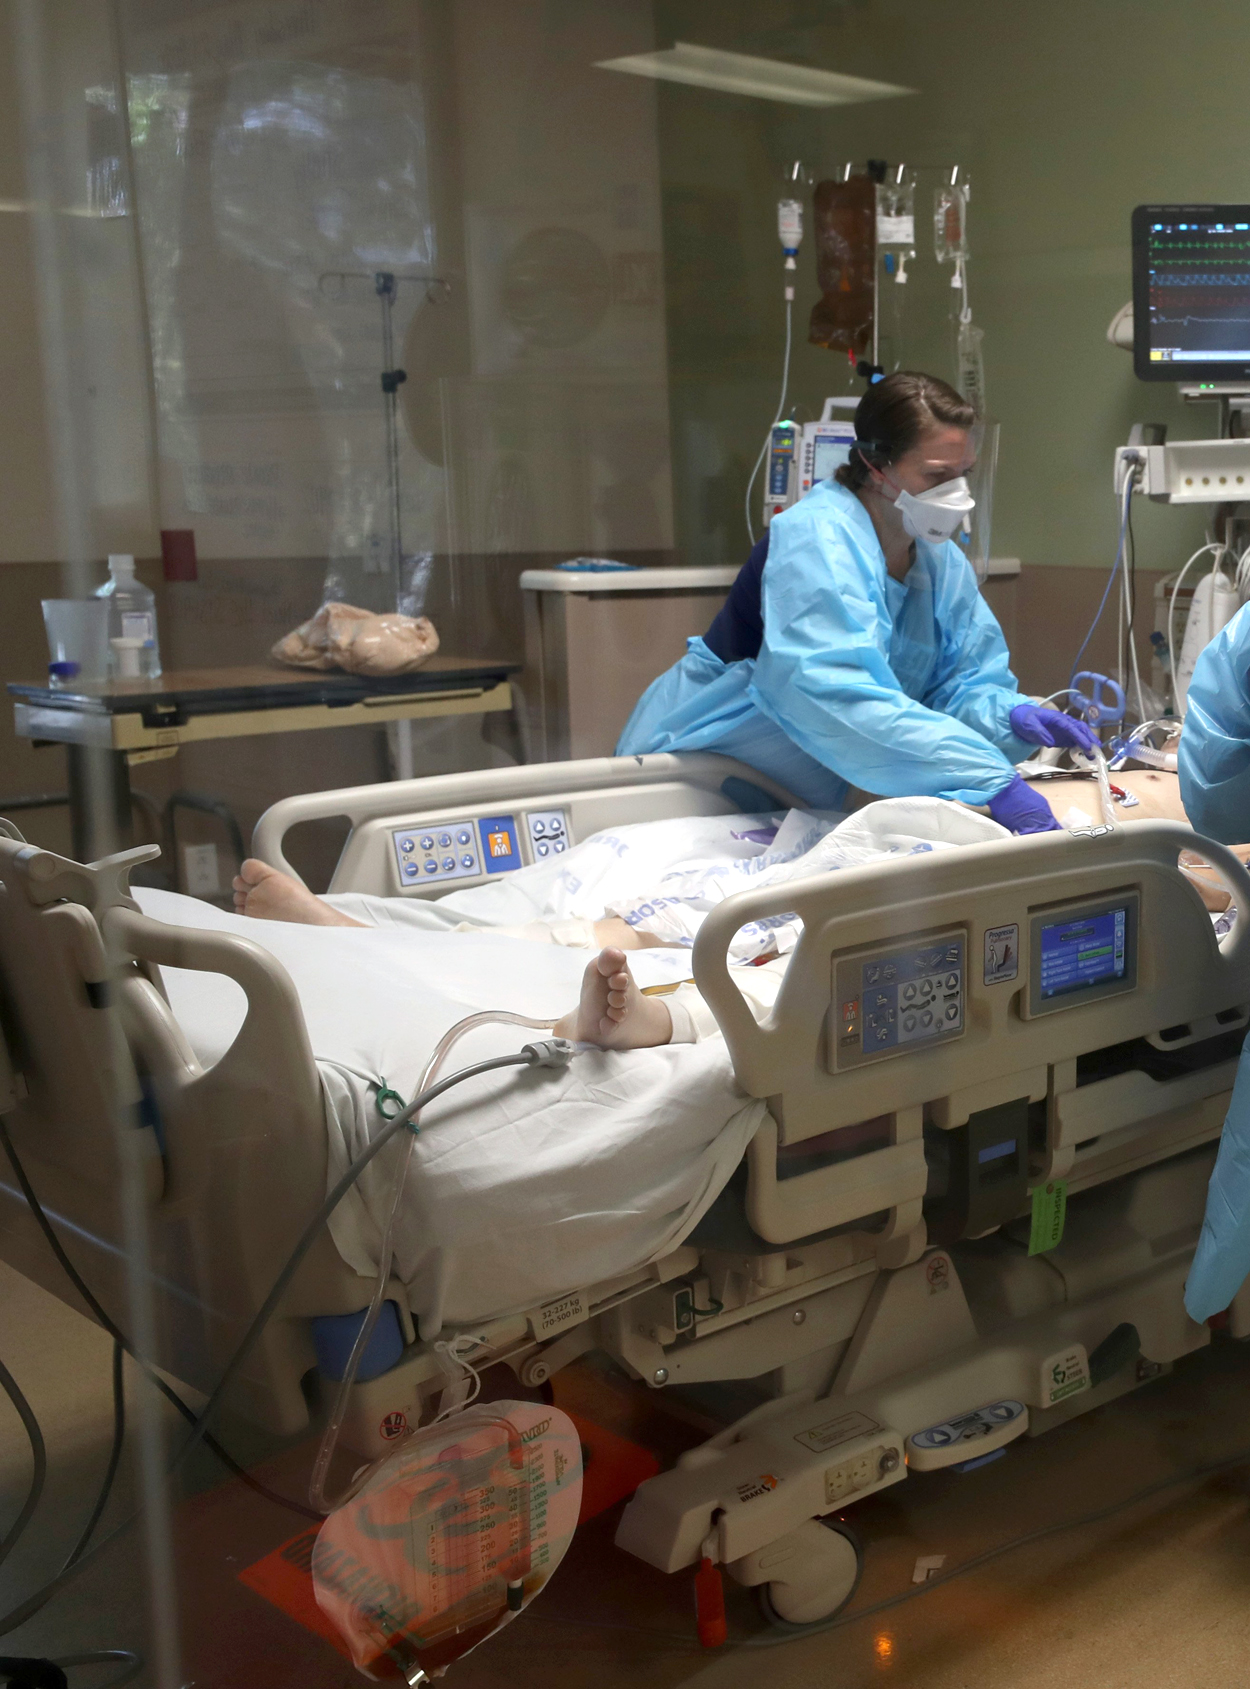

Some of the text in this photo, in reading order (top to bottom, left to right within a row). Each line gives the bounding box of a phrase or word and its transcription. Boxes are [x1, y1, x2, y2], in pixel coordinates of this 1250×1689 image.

[1051, 1187, 1062, 1241] INSPECTED
[542, 1298, 580, 1320] 32-227 kg
[542, 1311, 571, 1330] (70-500
[480, 1486, 495, 1498] 350
[508, 1487, 518, 1496] 50
[740, 1488, 764, 1503] BRAKE
[480, 1502, 496, 1514] 300
[509, 1503, 518, 1512] 40
[481, 1521, 496, 1533] 250
[481, 1541, 496, 1553] 200
[482, 1561, 497, 1573] 150
